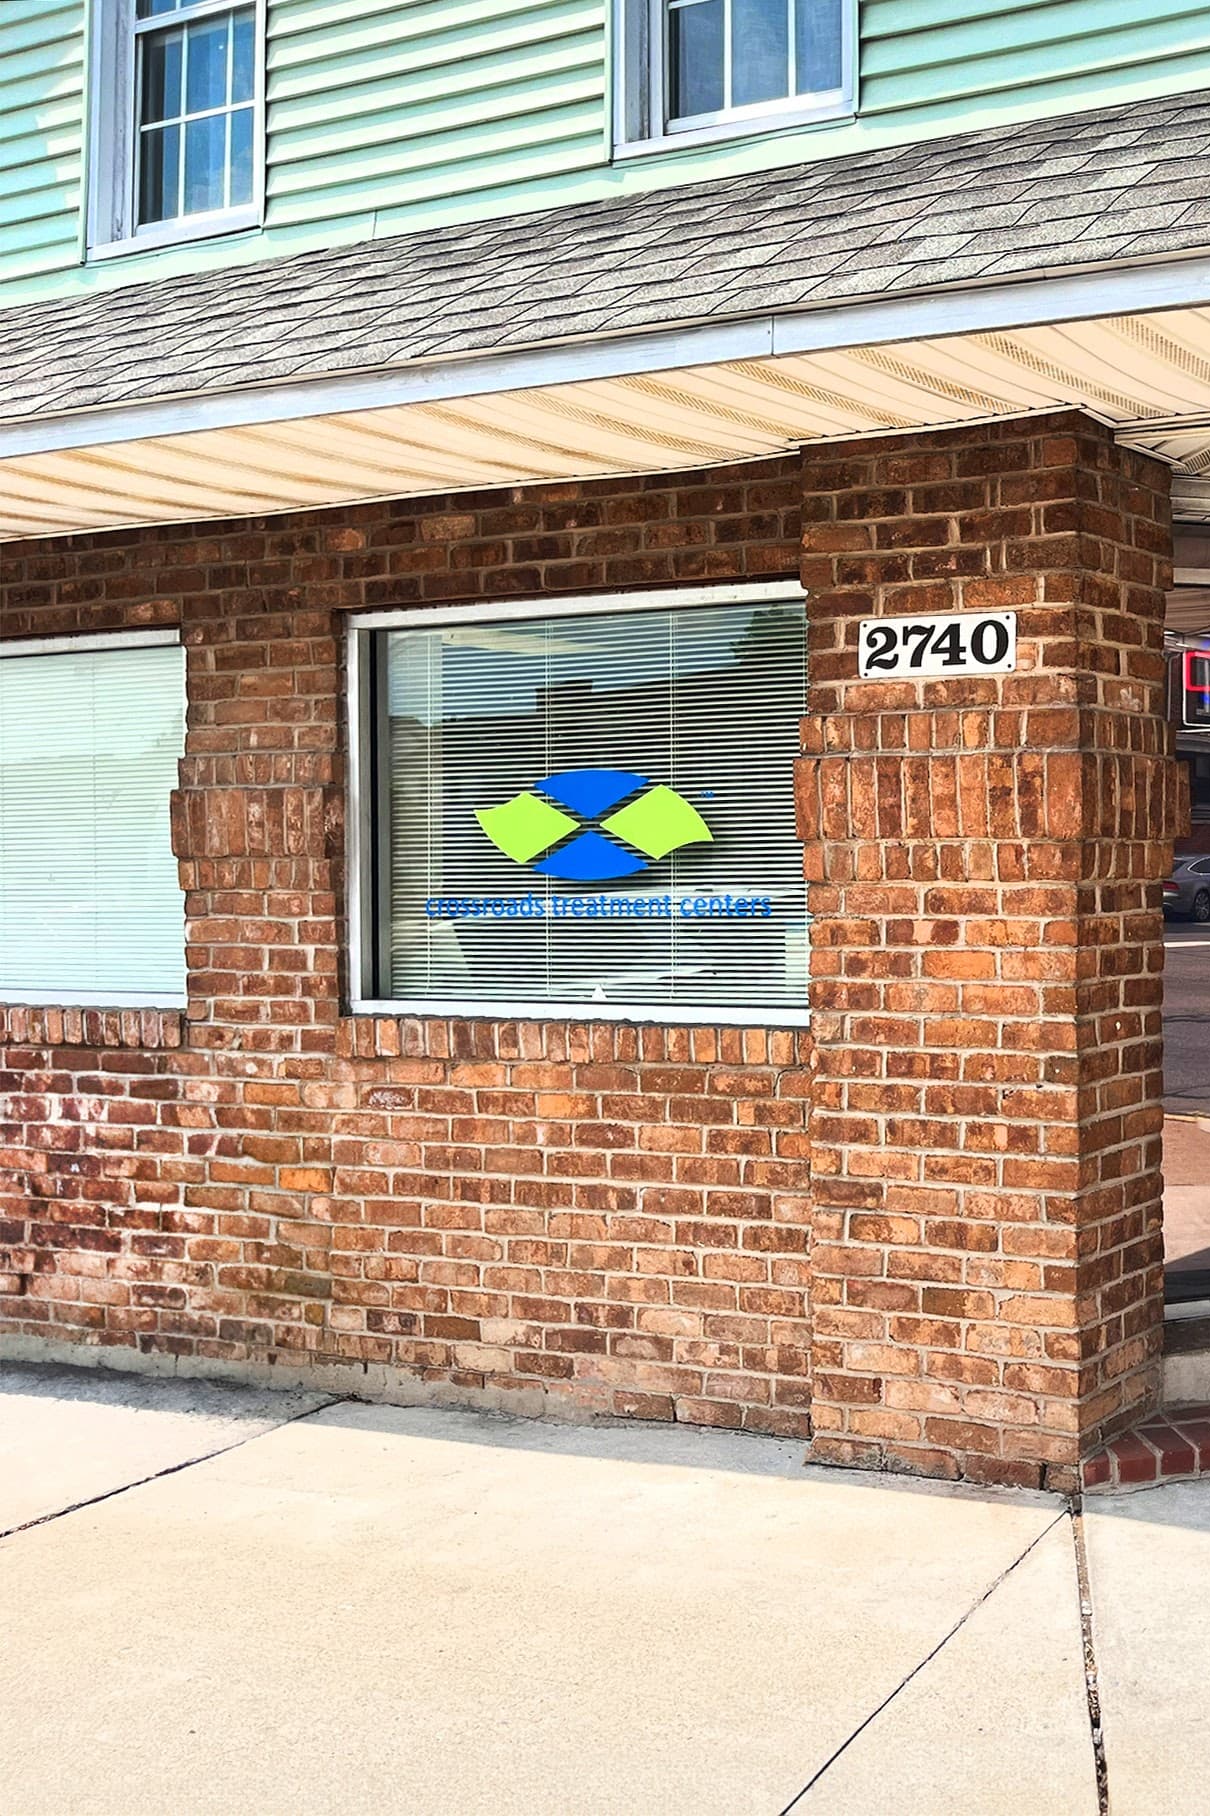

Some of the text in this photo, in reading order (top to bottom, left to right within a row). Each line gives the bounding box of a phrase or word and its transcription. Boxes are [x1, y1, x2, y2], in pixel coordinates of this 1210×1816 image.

[865, 619, 1010, 670] 2740
[425, 892, 773, 917] crossroads treatment centers
